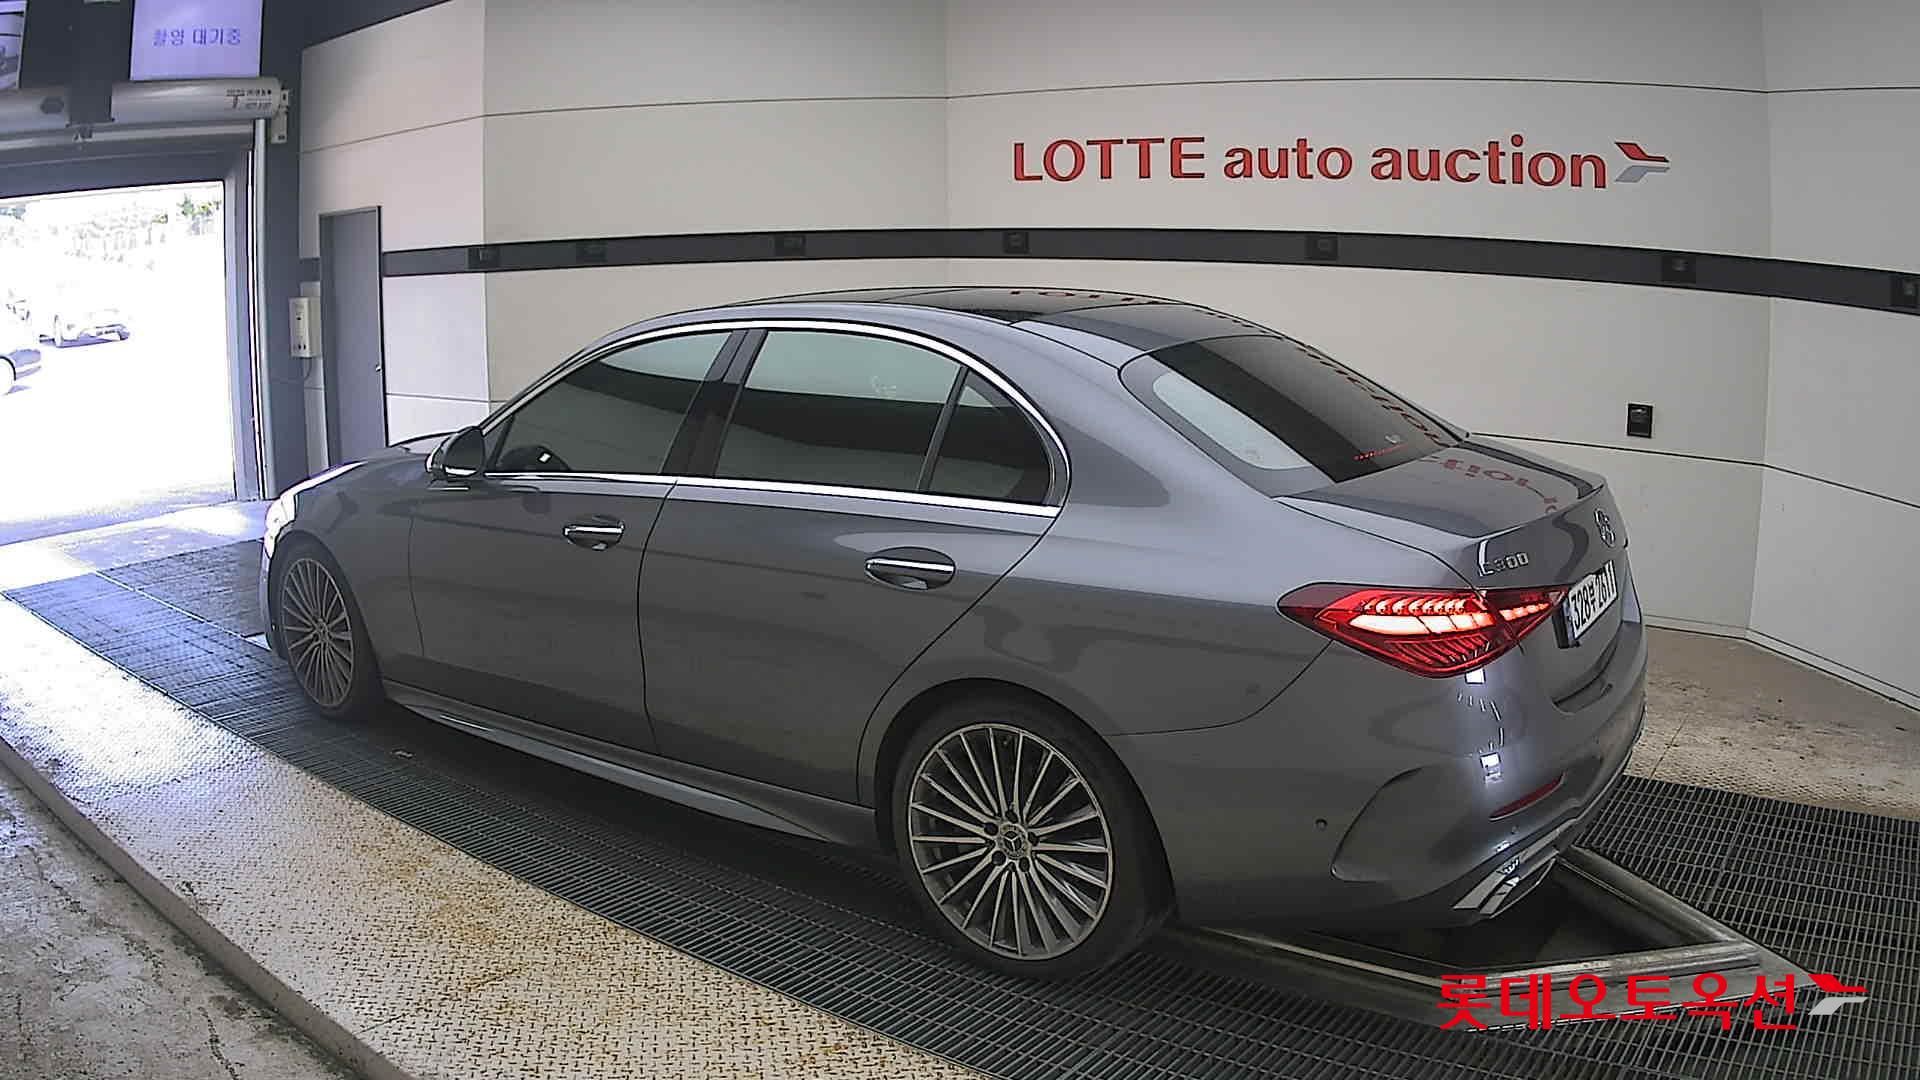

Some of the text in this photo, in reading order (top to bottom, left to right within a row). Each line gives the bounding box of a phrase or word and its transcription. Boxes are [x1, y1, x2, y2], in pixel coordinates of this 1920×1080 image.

[192, 25, 241, 46] 대기중
[1013, 134, 1607, 189] LOTTE auto auction
